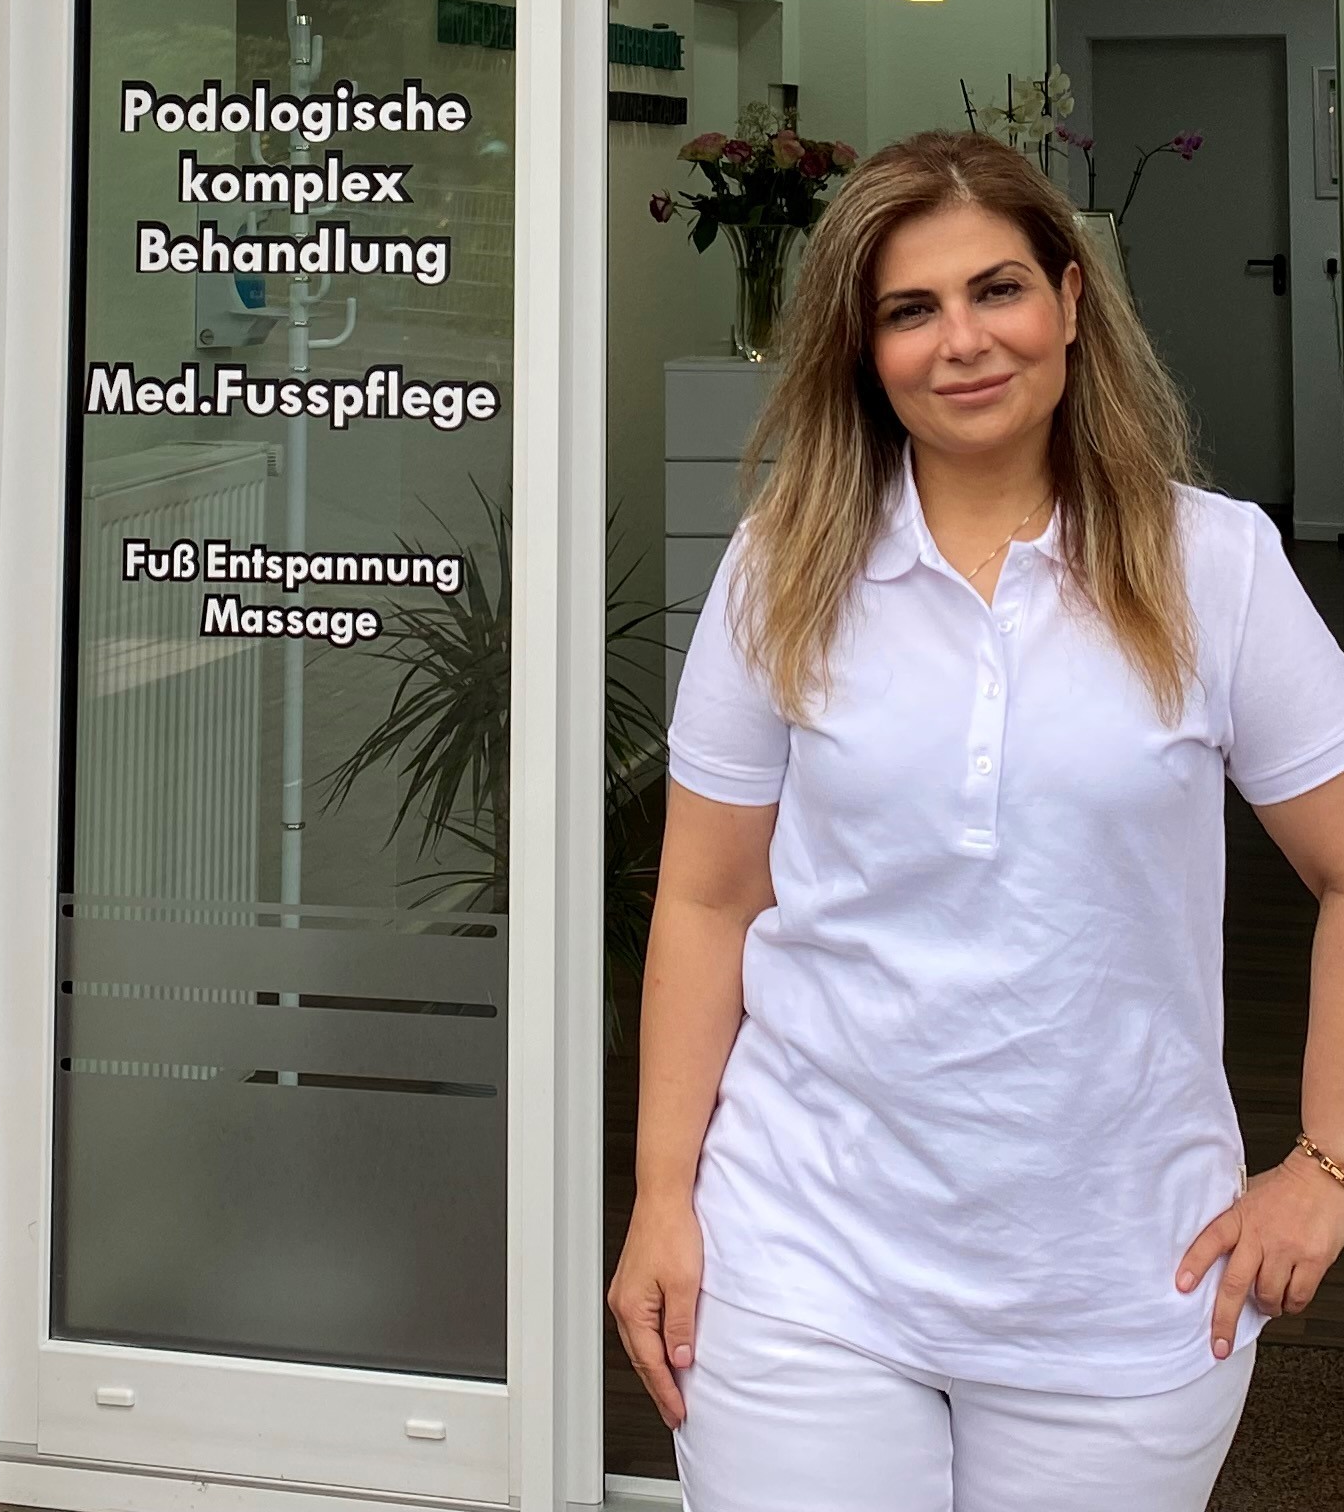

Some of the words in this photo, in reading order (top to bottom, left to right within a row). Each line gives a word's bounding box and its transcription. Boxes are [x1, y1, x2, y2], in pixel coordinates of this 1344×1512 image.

[121, 83, 471, 146] Podologische
[177, 154, 408, 216] komplex
[136, 225, 451, 287] Behandlung
[84, 365, 501, 431] Med.Fusspflege
[123, 541, 198, 581] Fuß
[204, 542, 462, 594] Entspannung
[200, 594, 381, 649] Massage
